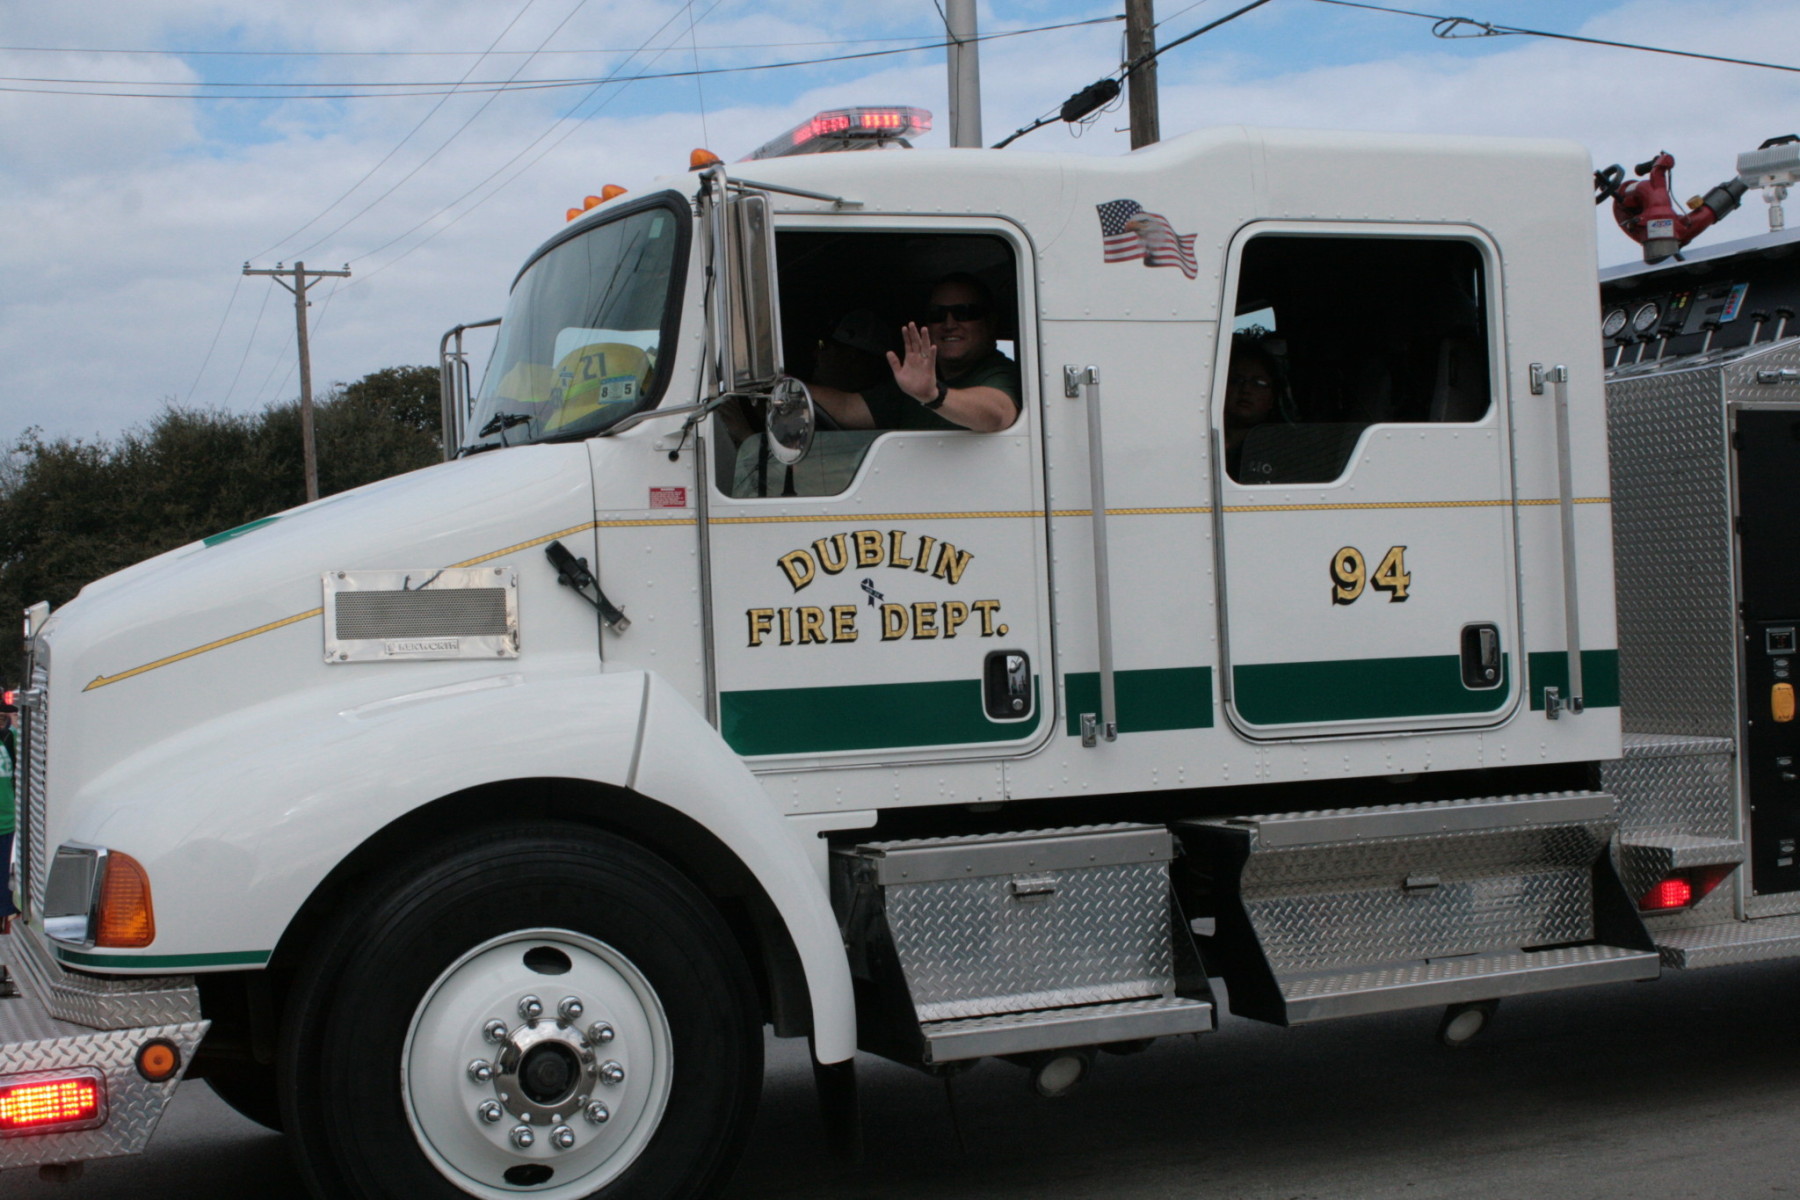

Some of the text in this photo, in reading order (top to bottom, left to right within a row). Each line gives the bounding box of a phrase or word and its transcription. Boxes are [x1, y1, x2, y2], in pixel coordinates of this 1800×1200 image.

[624, 383, 632, 395] 5
[777, 530, 974, 593] DUBLIN
[1330, 546, 1411, 606] 94
[746, 599, 1009, 647] FIRE DEPT.
